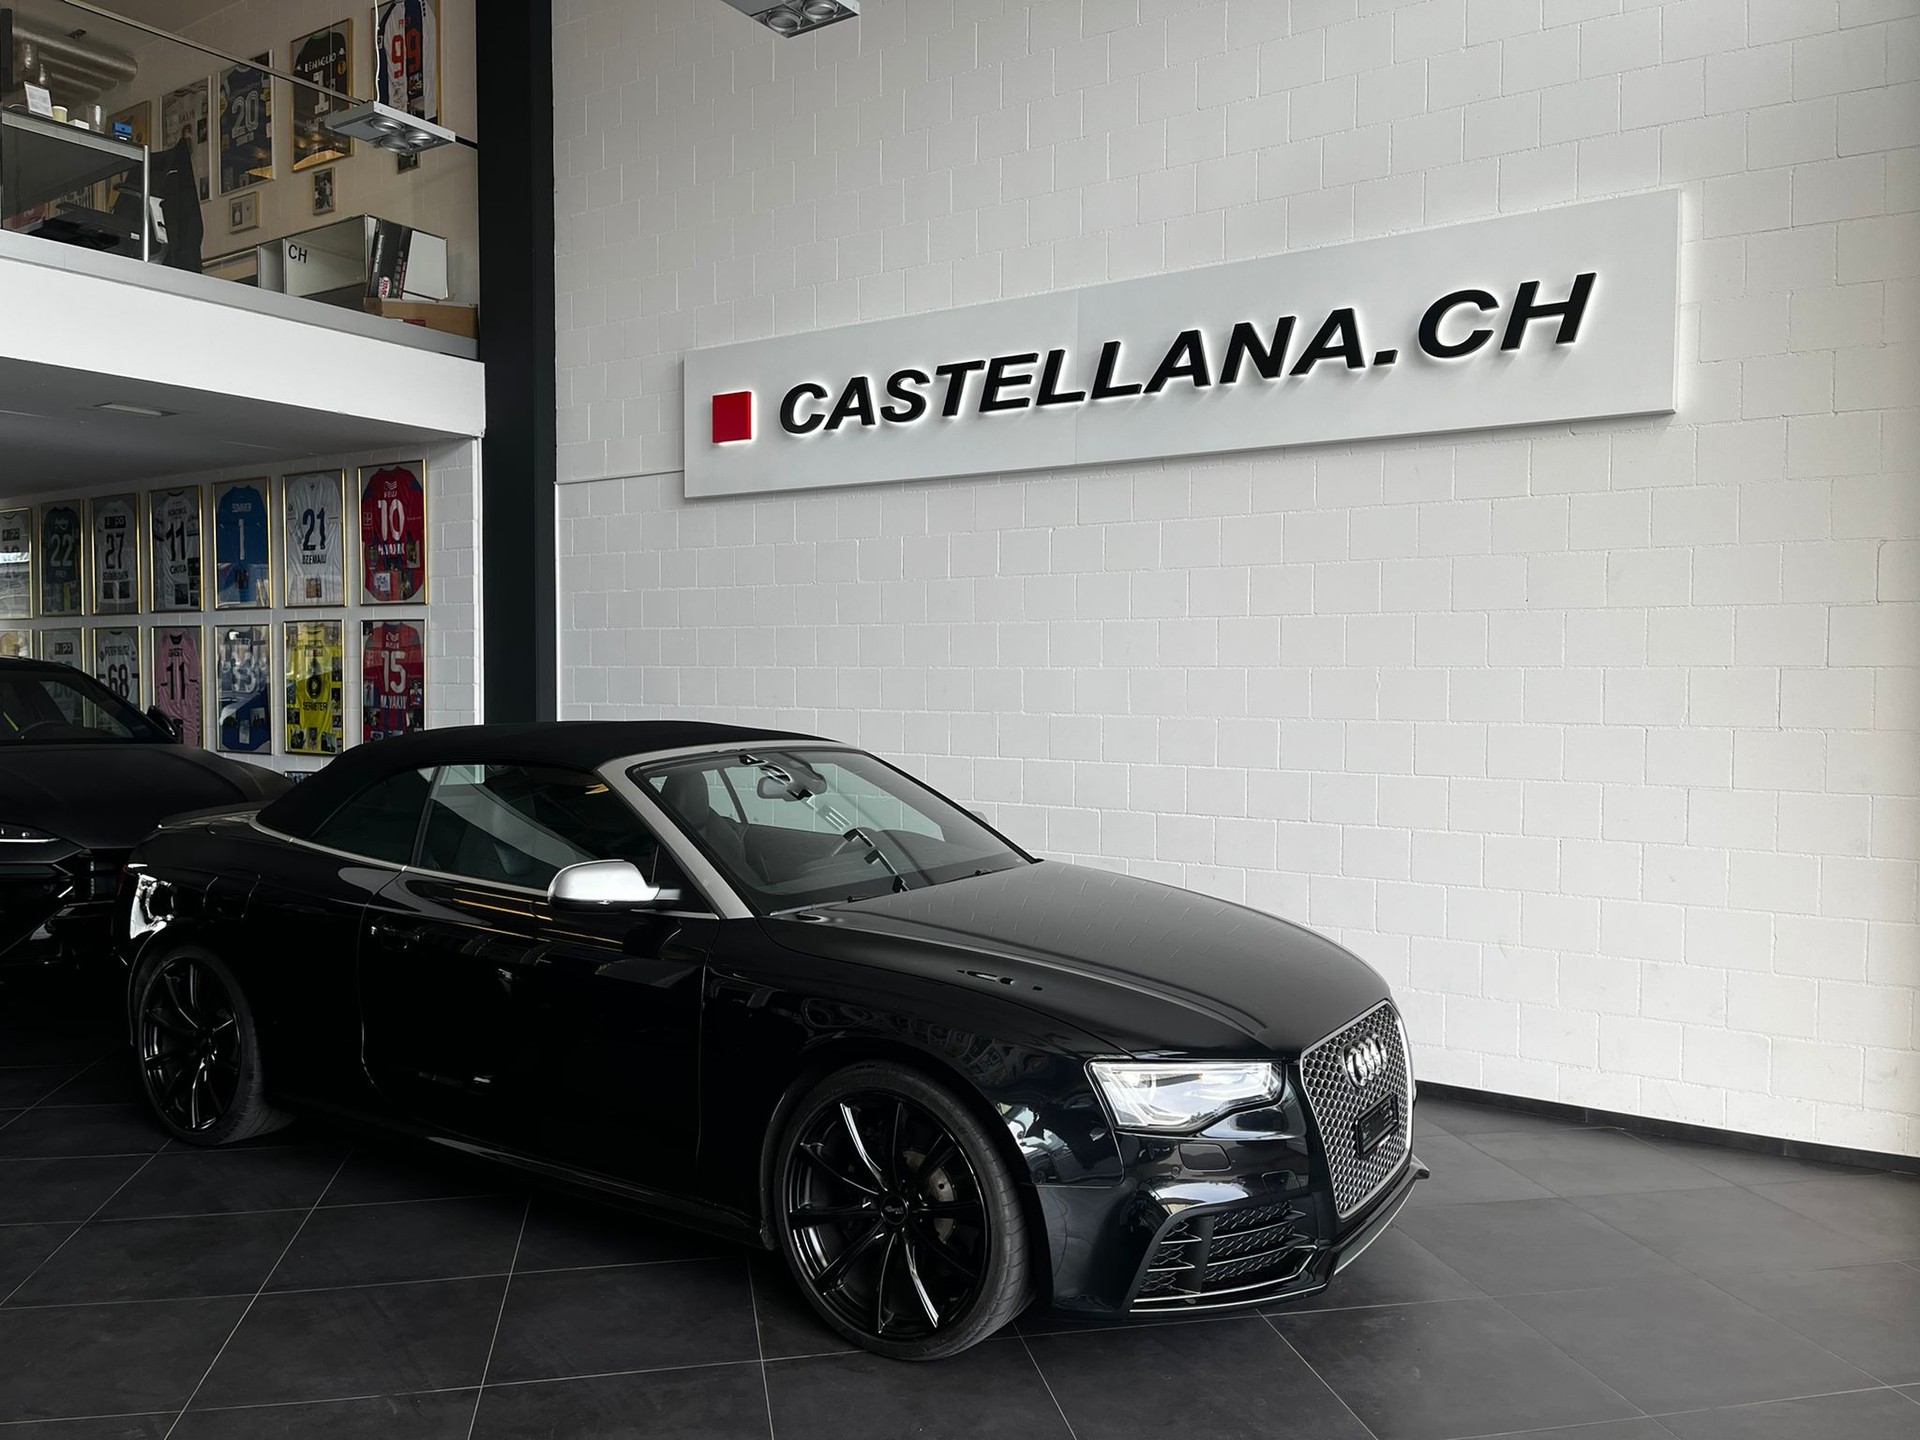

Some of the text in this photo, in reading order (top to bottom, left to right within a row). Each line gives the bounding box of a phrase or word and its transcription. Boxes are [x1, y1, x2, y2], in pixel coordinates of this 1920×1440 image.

[391, 28, 420, 79] 99
[231, 90, 260, 139] 20
[288, 244, 308, 264] CH
[779, 272, 1597, 434] CASTELLANA.CH
[165, 521, 186, 562] 11
[302, 507, 327, 551] 21
[378, 499, 405, 542] 10
[49, 533, 73, 568] 22
[105, 532, 125, 570] 27
[108, 663, 129, 700] 68
[166, 661, 186, 700] 11
[381, 650, 407, 694] 15
